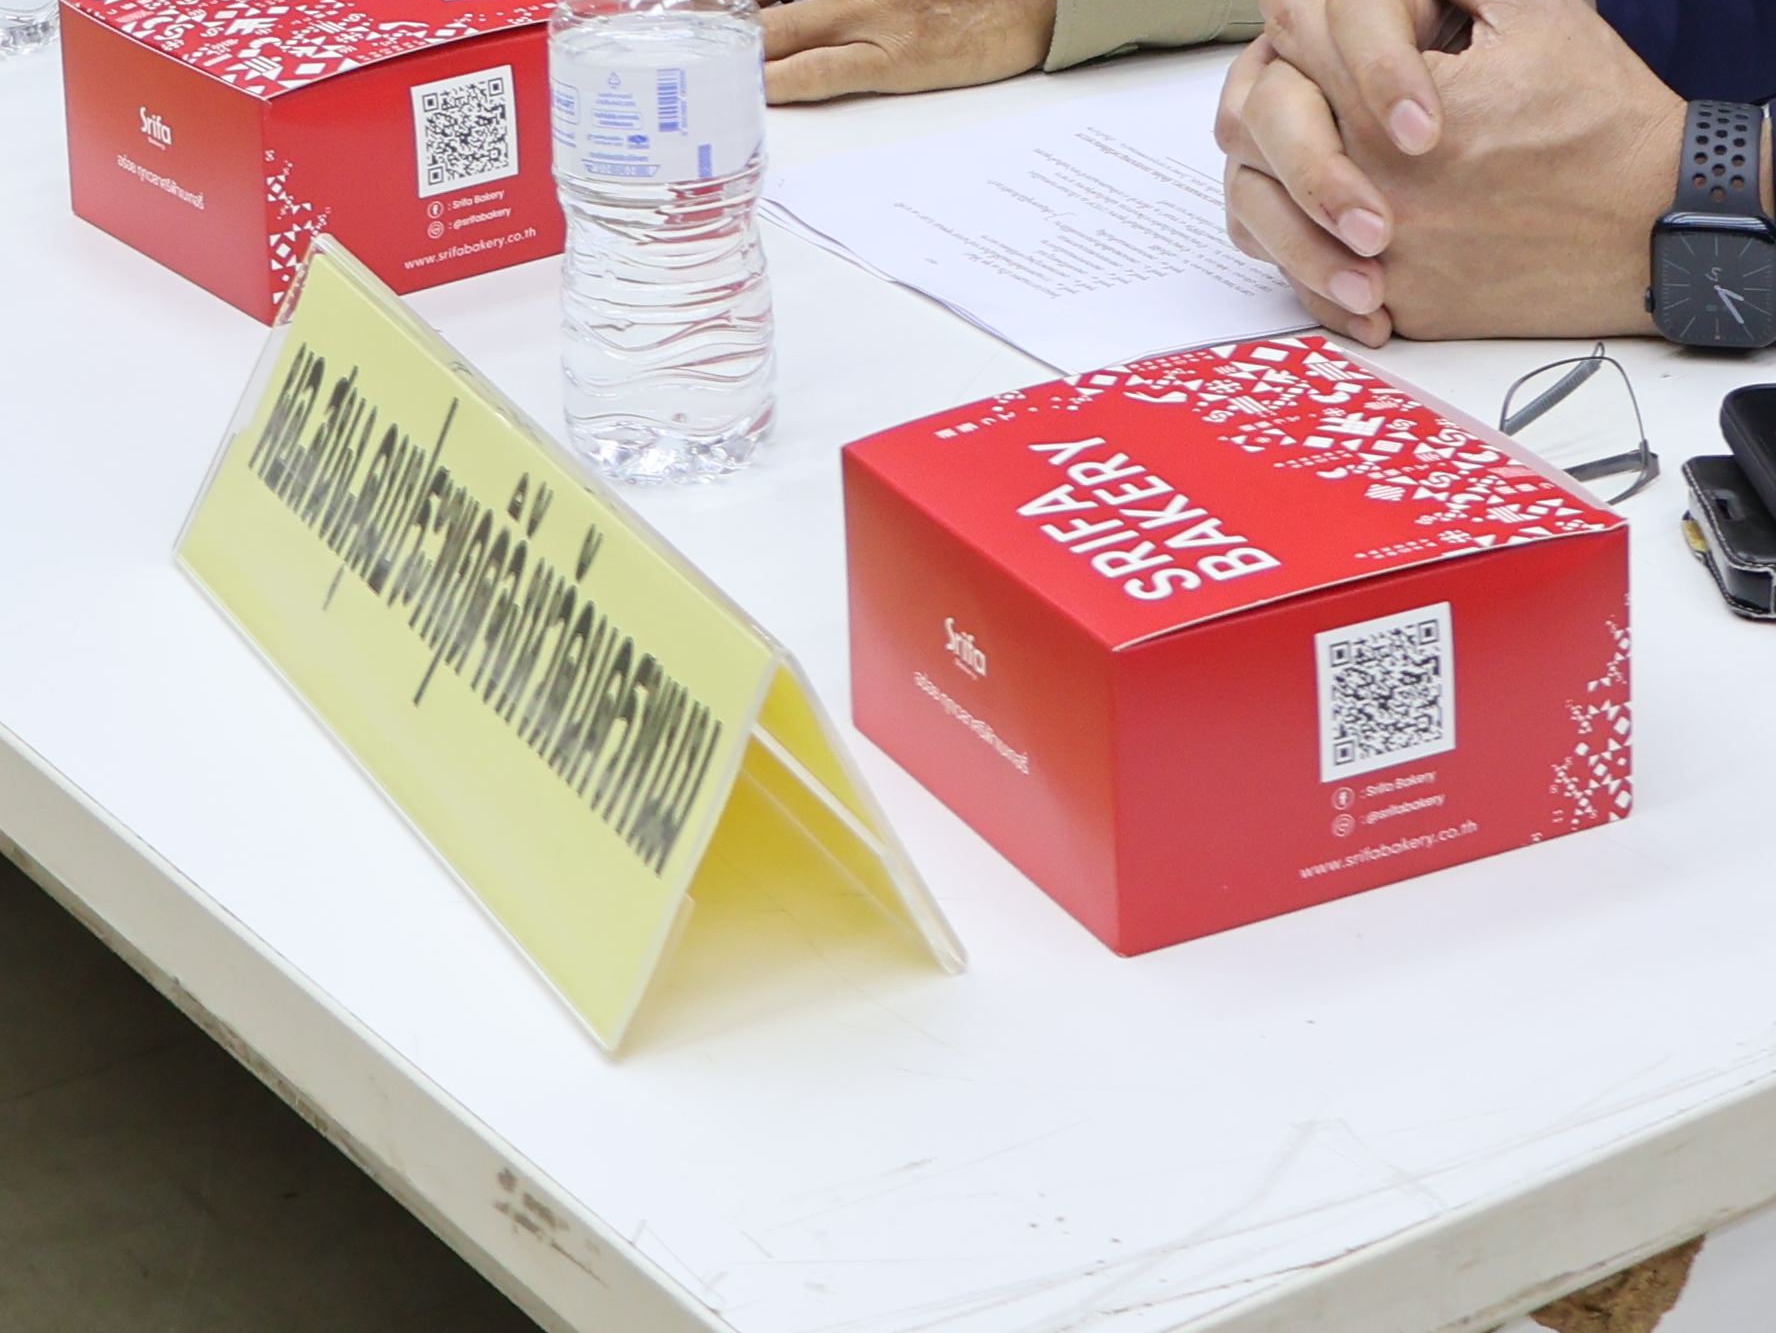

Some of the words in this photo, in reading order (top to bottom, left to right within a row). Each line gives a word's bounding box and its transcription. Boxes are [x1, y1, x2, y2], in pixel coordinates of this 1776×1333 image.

[140, 107, 172, 145] Srifa
[404, 227, 537, 270] www.srifabakery.co.th
[1028, 436, 1283, 582] BAKERY
[1016, 483, 1203, 601] SRIFA
[944, 616, 988, 677] Srifa
[1298, 819, 1479, 879] www.srifabakery.co.th
